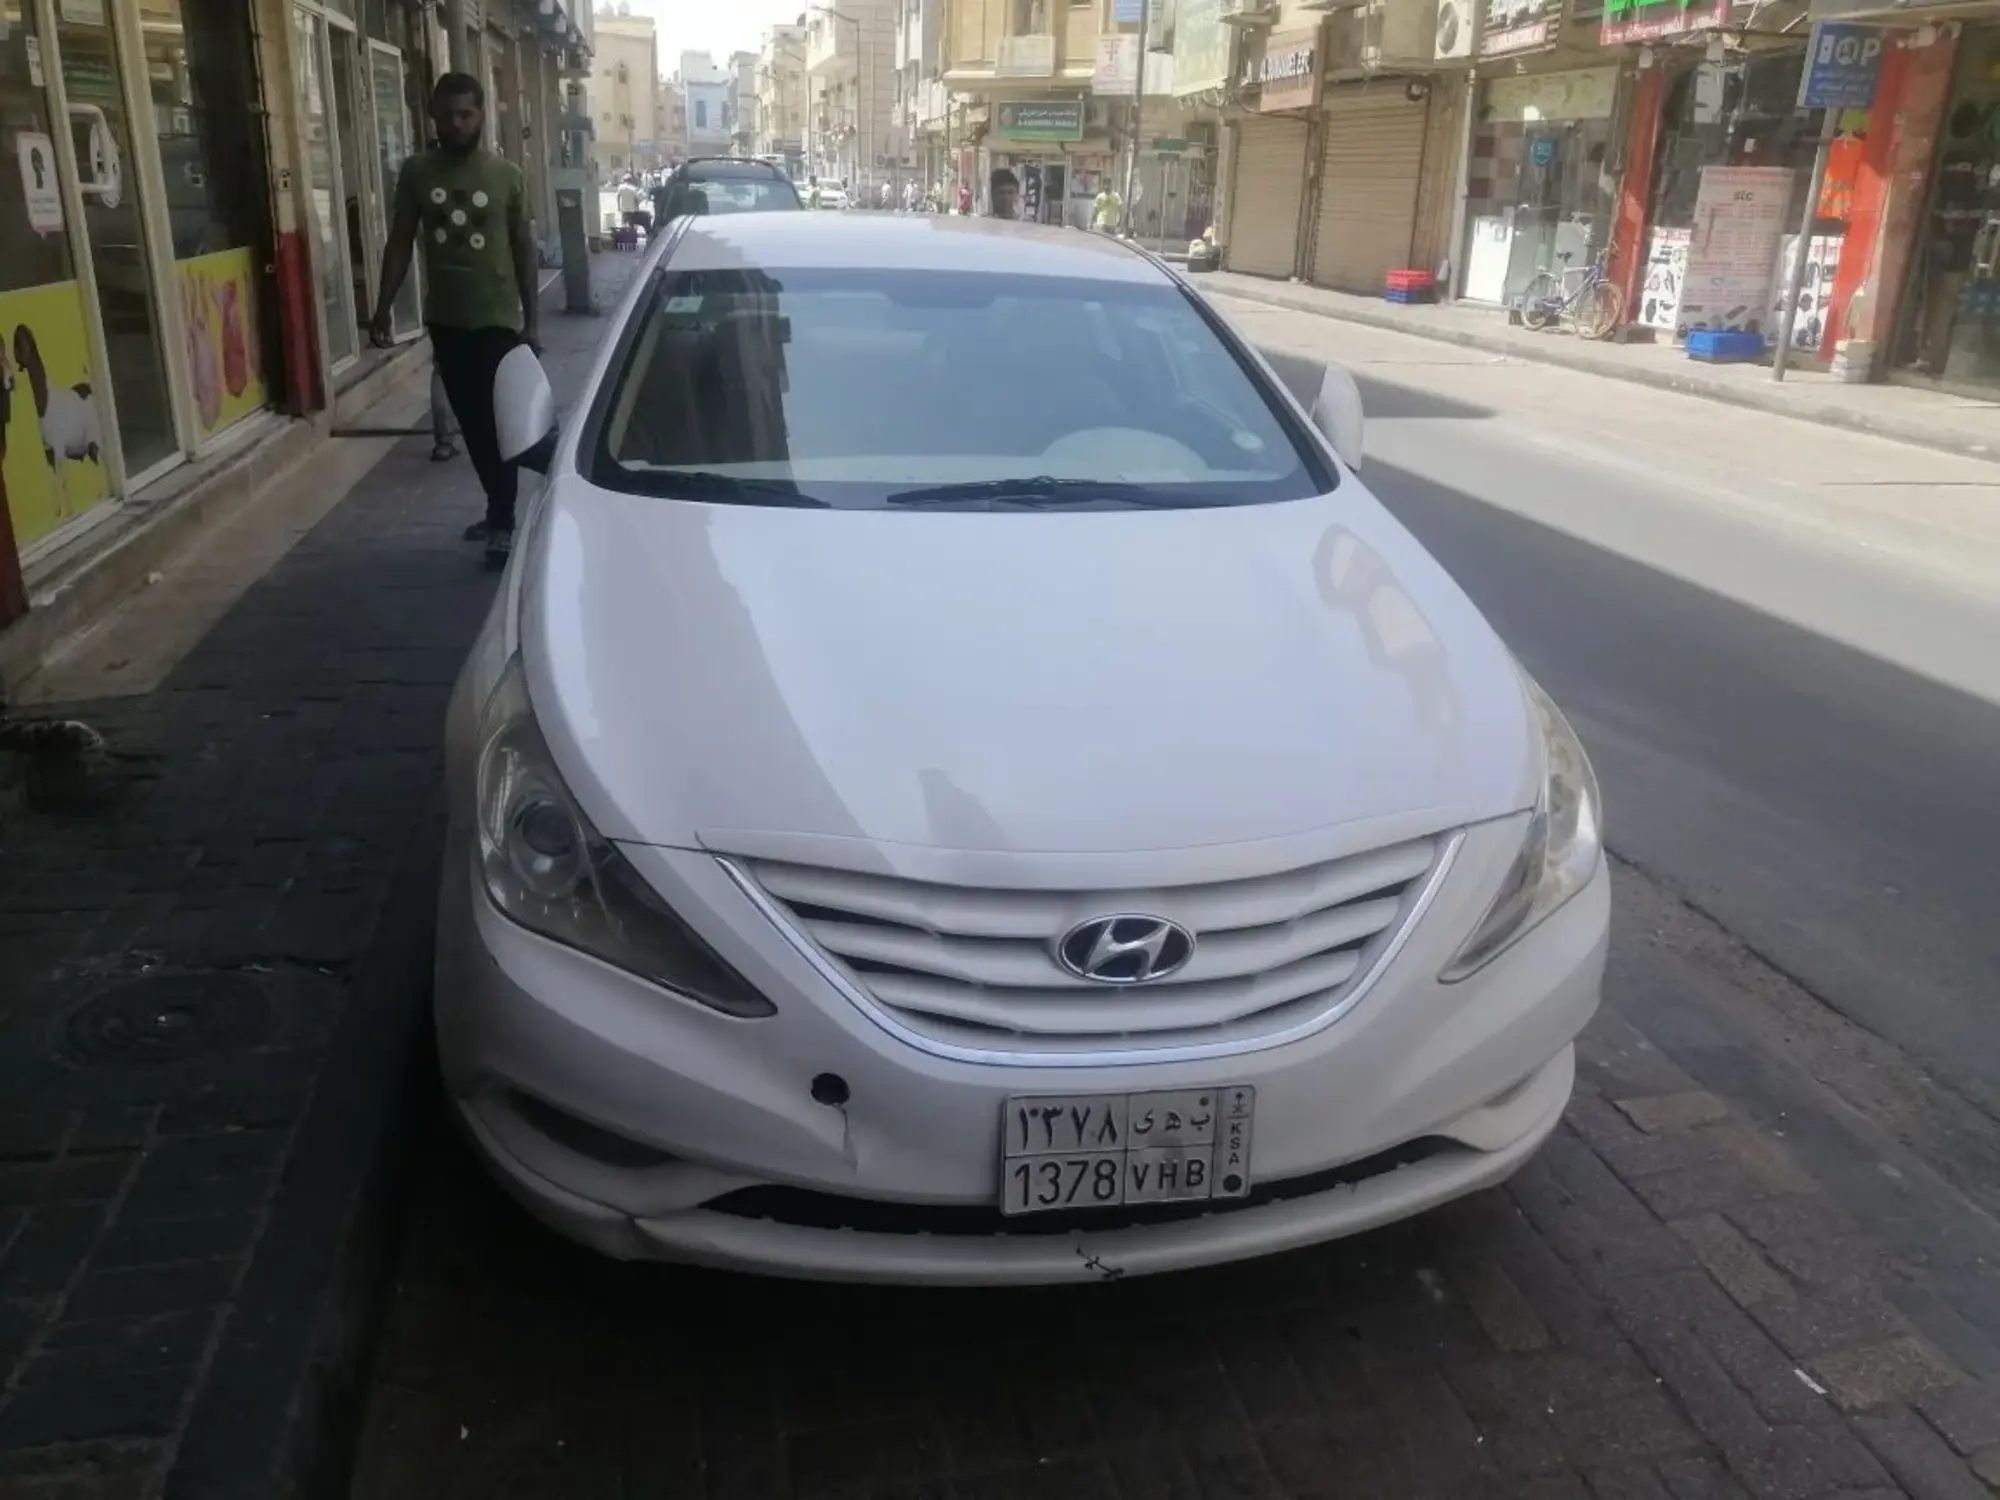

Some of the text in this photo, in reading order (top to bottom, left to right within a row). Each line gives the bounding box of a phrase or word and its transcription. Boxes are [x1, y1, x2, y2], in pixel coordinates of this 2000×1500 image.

[1018, 1104, 1118, 1150] ١٣٧٨
[1229, 1122, 1242, 1165] KSA
[1015, 1159, 1206, 1207] 1378 VHB
